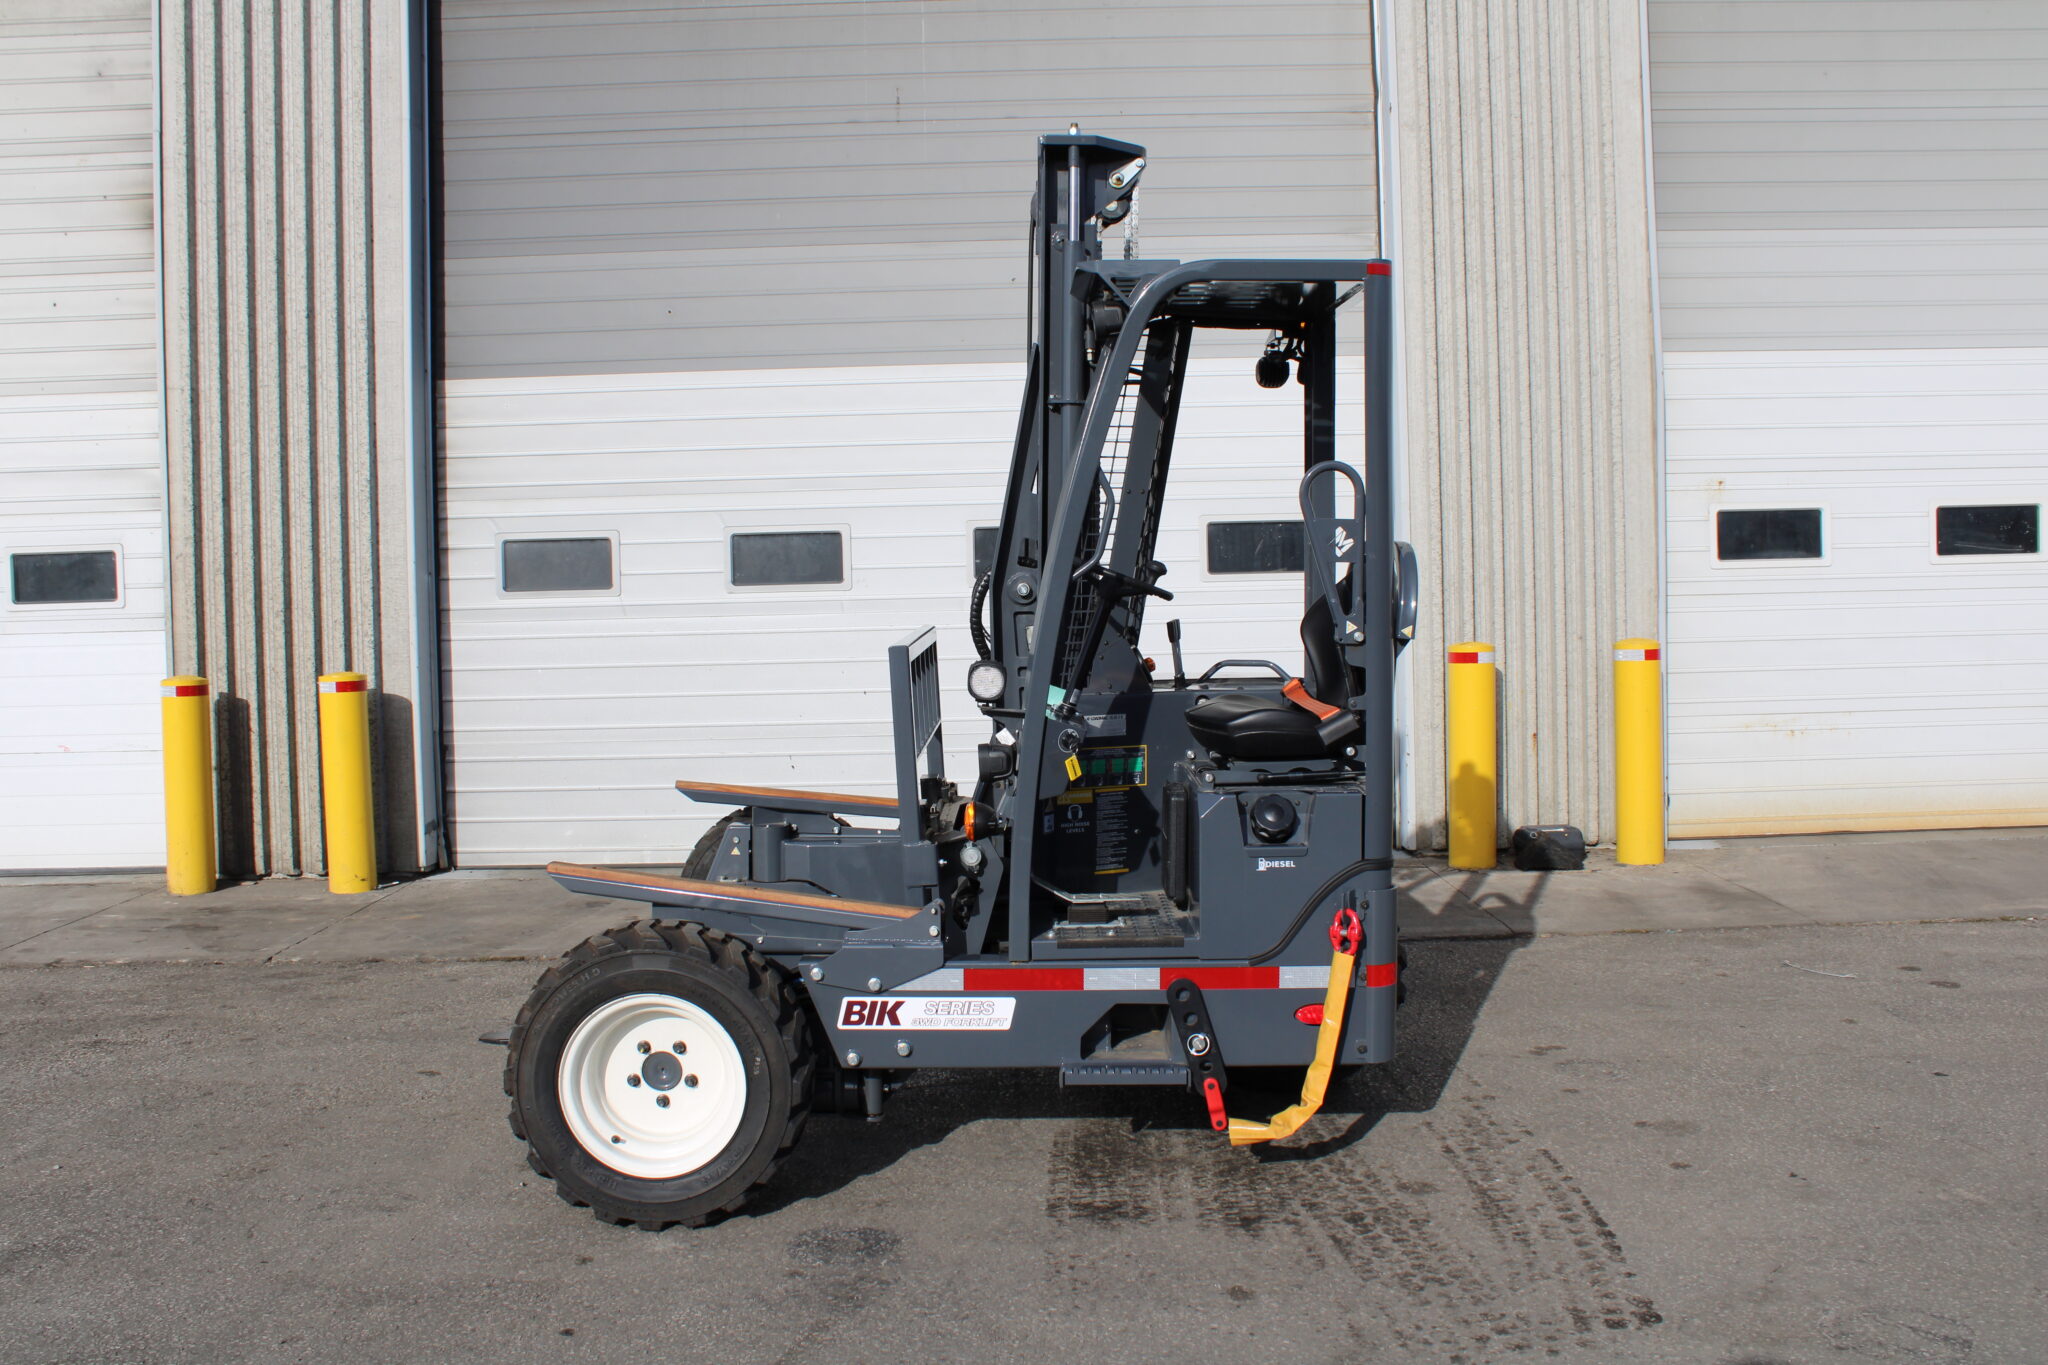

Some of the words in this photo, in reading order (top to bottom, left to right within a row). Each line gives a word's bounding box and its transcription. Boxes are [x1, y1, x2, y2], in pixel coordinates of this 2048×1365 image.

[1265, 860, 1296, 868] DIESEL
[841, 1000, 906, 1026] BIK
[923, 1000, 995, 1016] SERIES
[943, 1017, 1008, 1027] FORKLIFT
